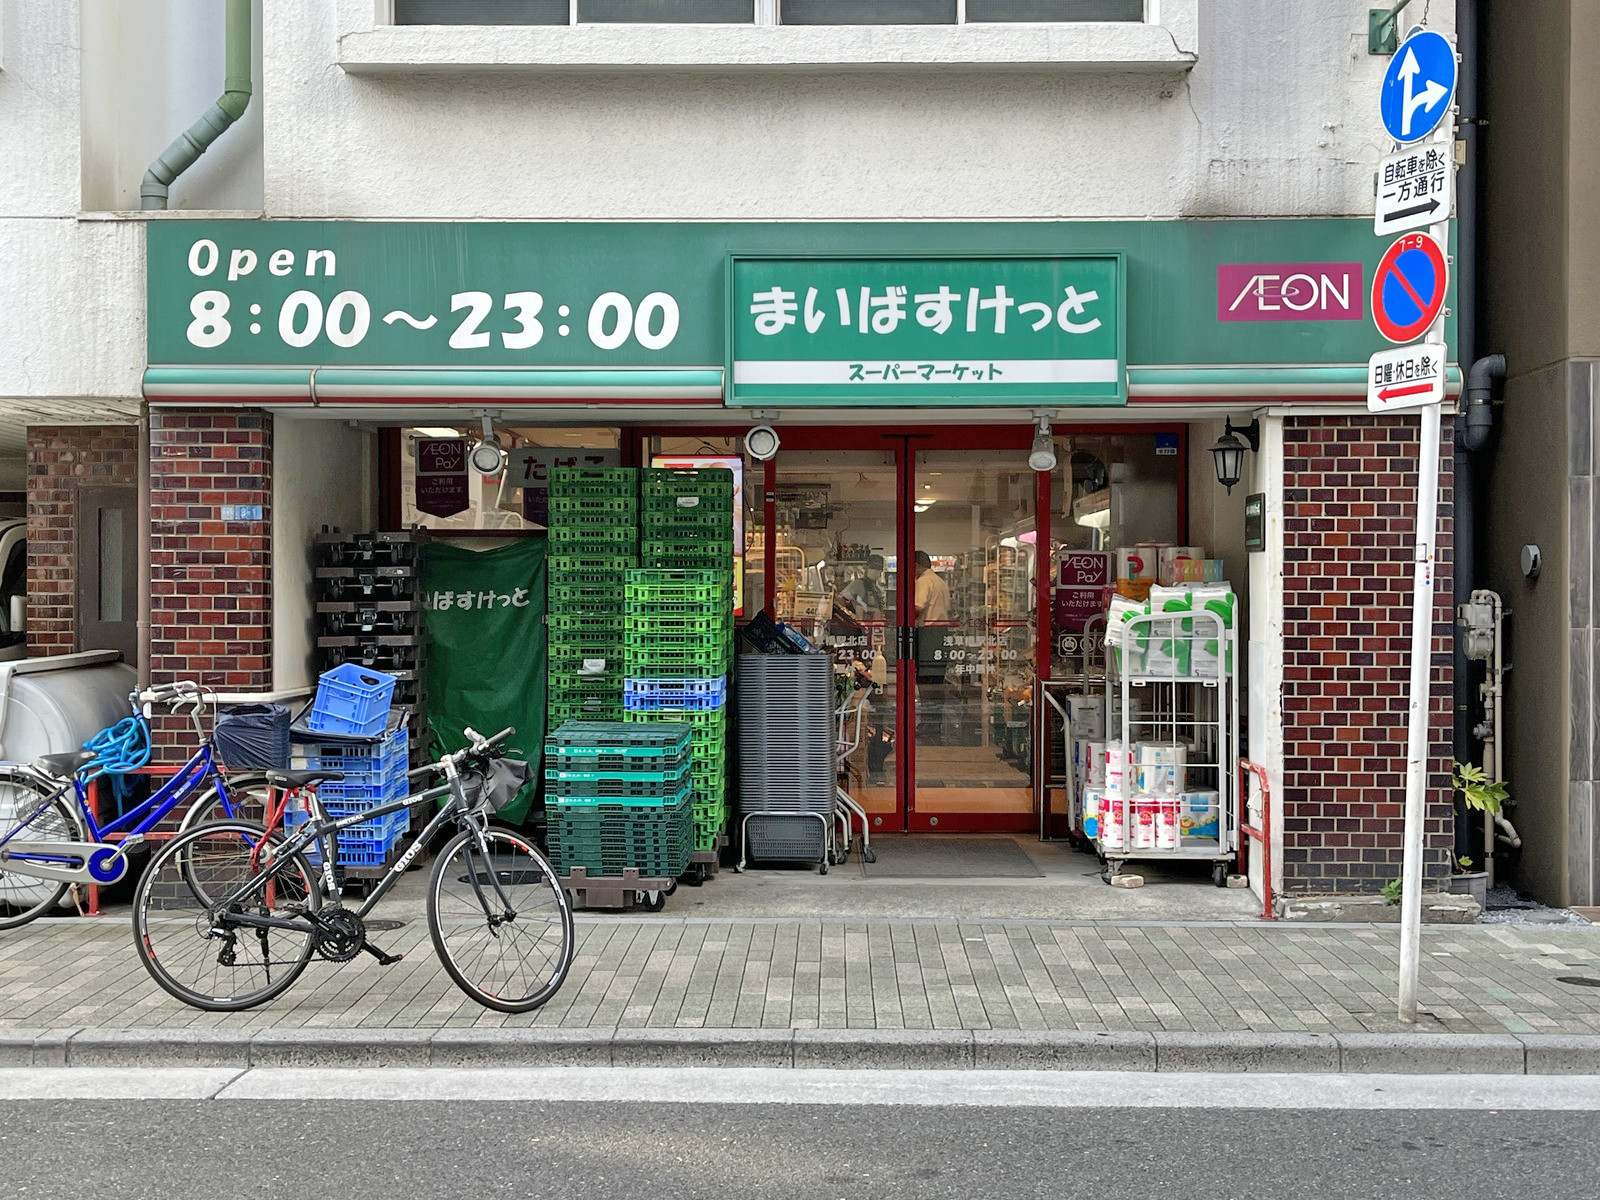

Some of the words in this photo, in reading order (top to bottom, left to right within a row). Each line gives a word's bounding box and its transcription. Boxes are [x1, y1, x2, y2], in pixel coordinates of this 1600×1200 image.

[1384, 149, 1446, 184] 自転車を除く
[1383, 171, 1445, 203] 一方通行
[1399, 235, 1423, 253] 7-9
[187, 239, 336, 281] Open
[750, 285, 1102, 336] まいばすけっと
[848, 363, 1003, 381] スーパーマーケット
[435, 457, 461, 469] Pay
[1077, 571, 1103, 583] Pay
[426, 587, 530, 611] ばすけっと
[1072, 591, 1095, 599] ご利用
[394, 841, 423, 872] GIOS
[322, 861, 336, 891] GIOS
